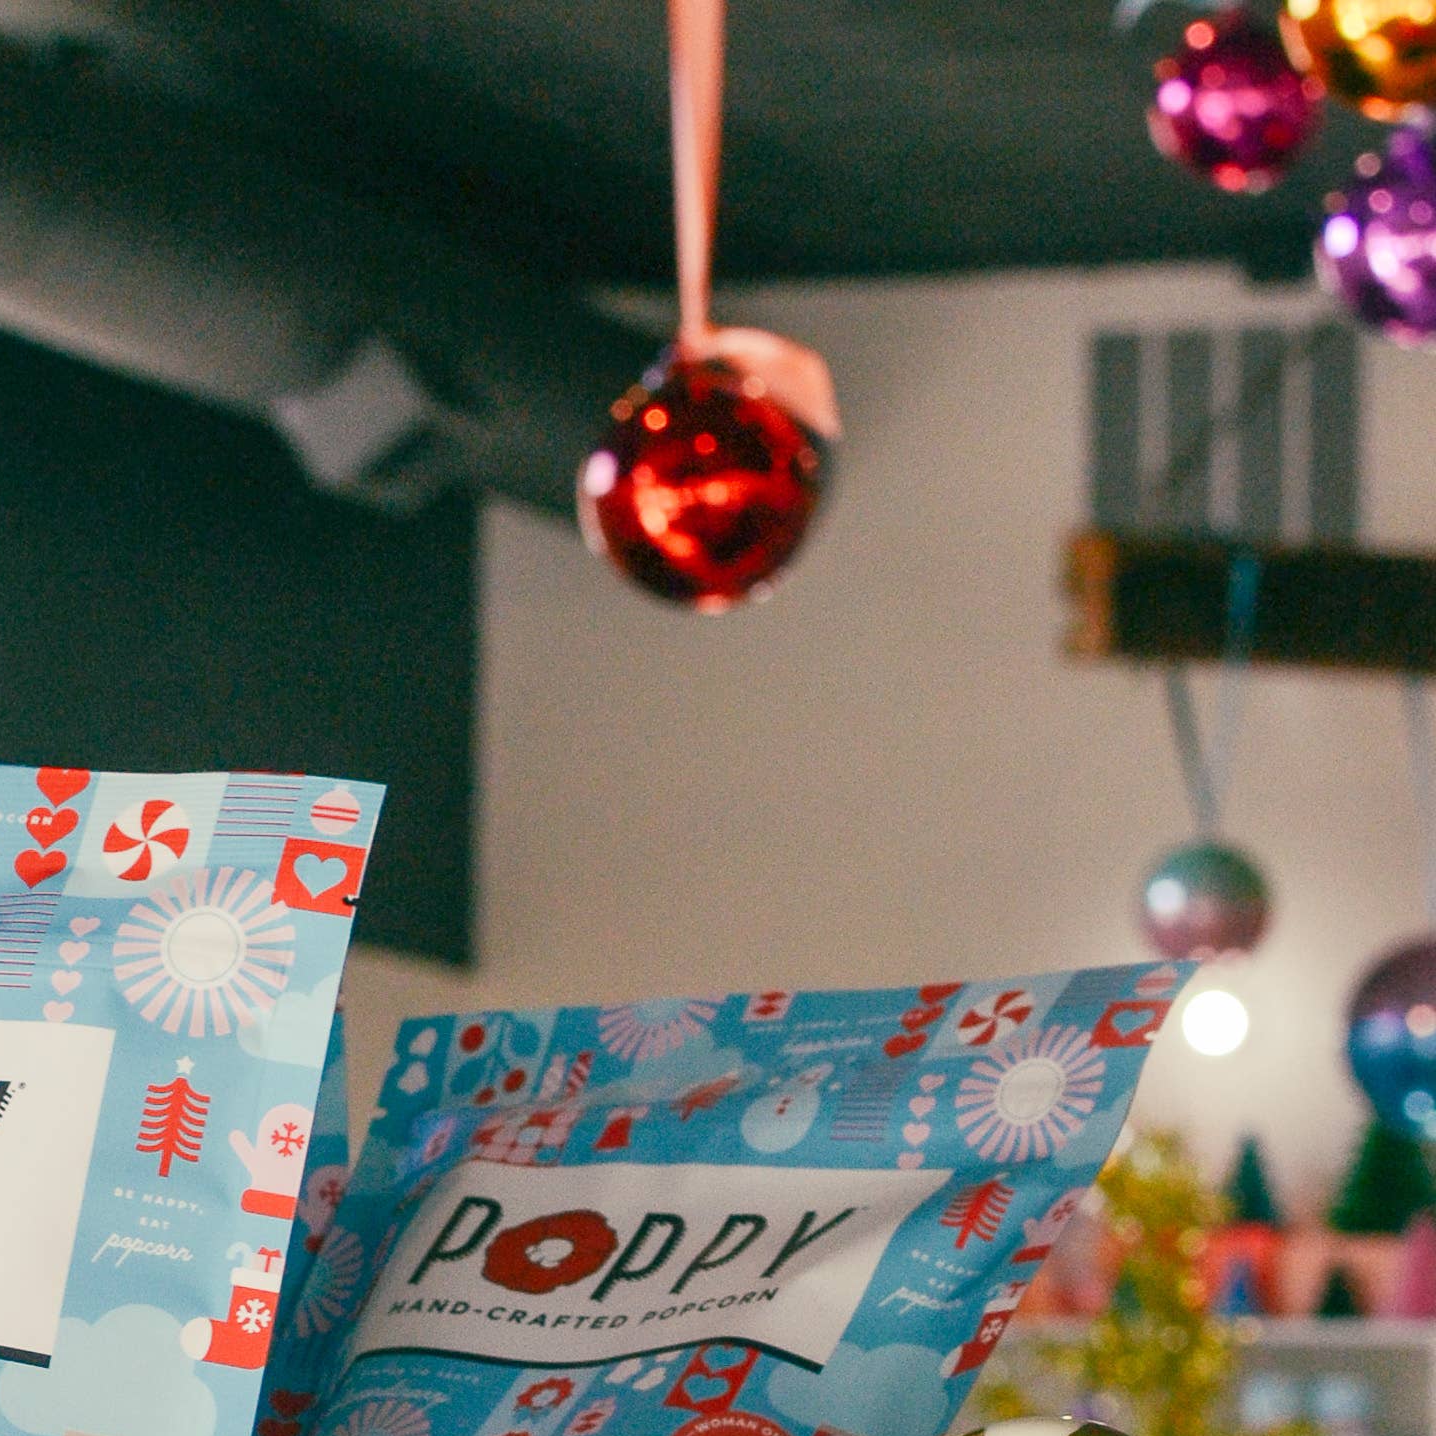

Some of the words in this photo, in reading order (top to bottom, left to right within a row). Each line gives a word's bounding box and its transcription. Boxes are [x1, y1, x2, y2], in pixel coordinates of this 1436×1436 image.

[91, 1233, 194, 1268] popcorn
[387, 1298, 631, 1332] HAND-CRAFTED
[638, 1286, 780, 1326] POPCORN
[694, 1417, 758, 1433] WOMAN
